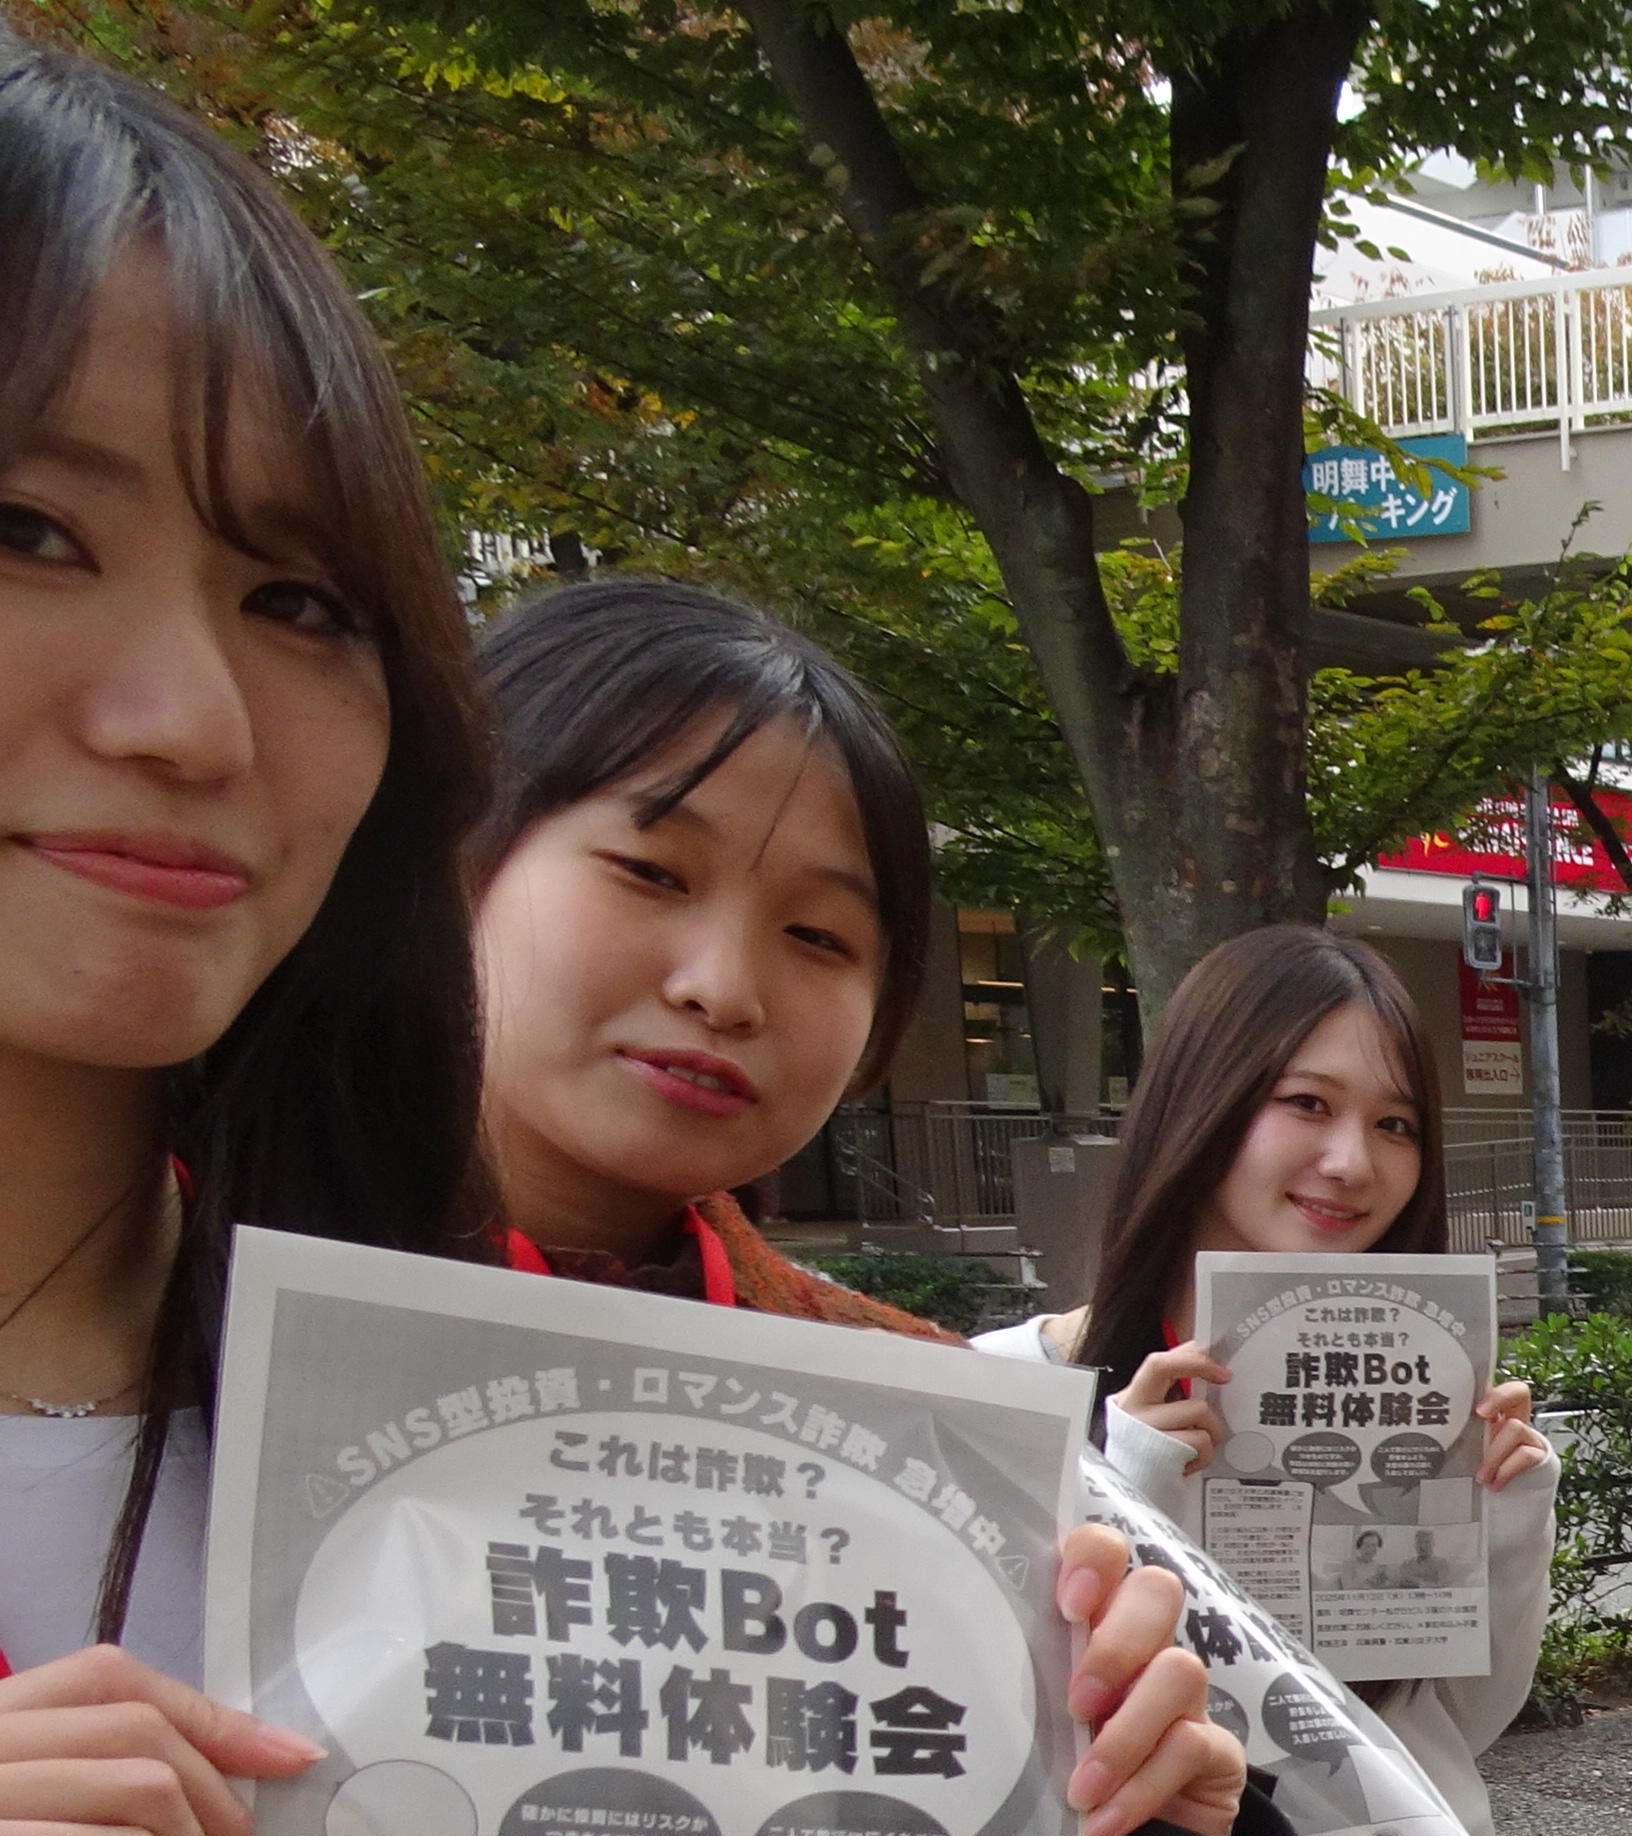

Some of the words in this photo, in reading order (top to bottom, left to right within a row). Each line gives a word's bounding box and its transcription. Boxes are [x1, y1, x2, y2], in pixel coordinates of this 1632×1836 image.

[1312, 455, 1415, 496] 明舞中
[1328, 486, 1458, 531] キング
[1285, 1353, 1431, 1388] 詐欺Bot
[1260, 1391, 1450, 1427] 無料体験会
[337, 1366, 888, 1486] SNS型投資・ロマンス詐欺
[895, 1450, 1007, 1562] 急増中
[549, 1429, 826, 1498] これは詐欺？
[519, 1493, 849, 1566] それとも本当？
[485, 1541, 909, 1668] 詐欺Bot
[424, 1640, 968, 1780] 無料体験会
